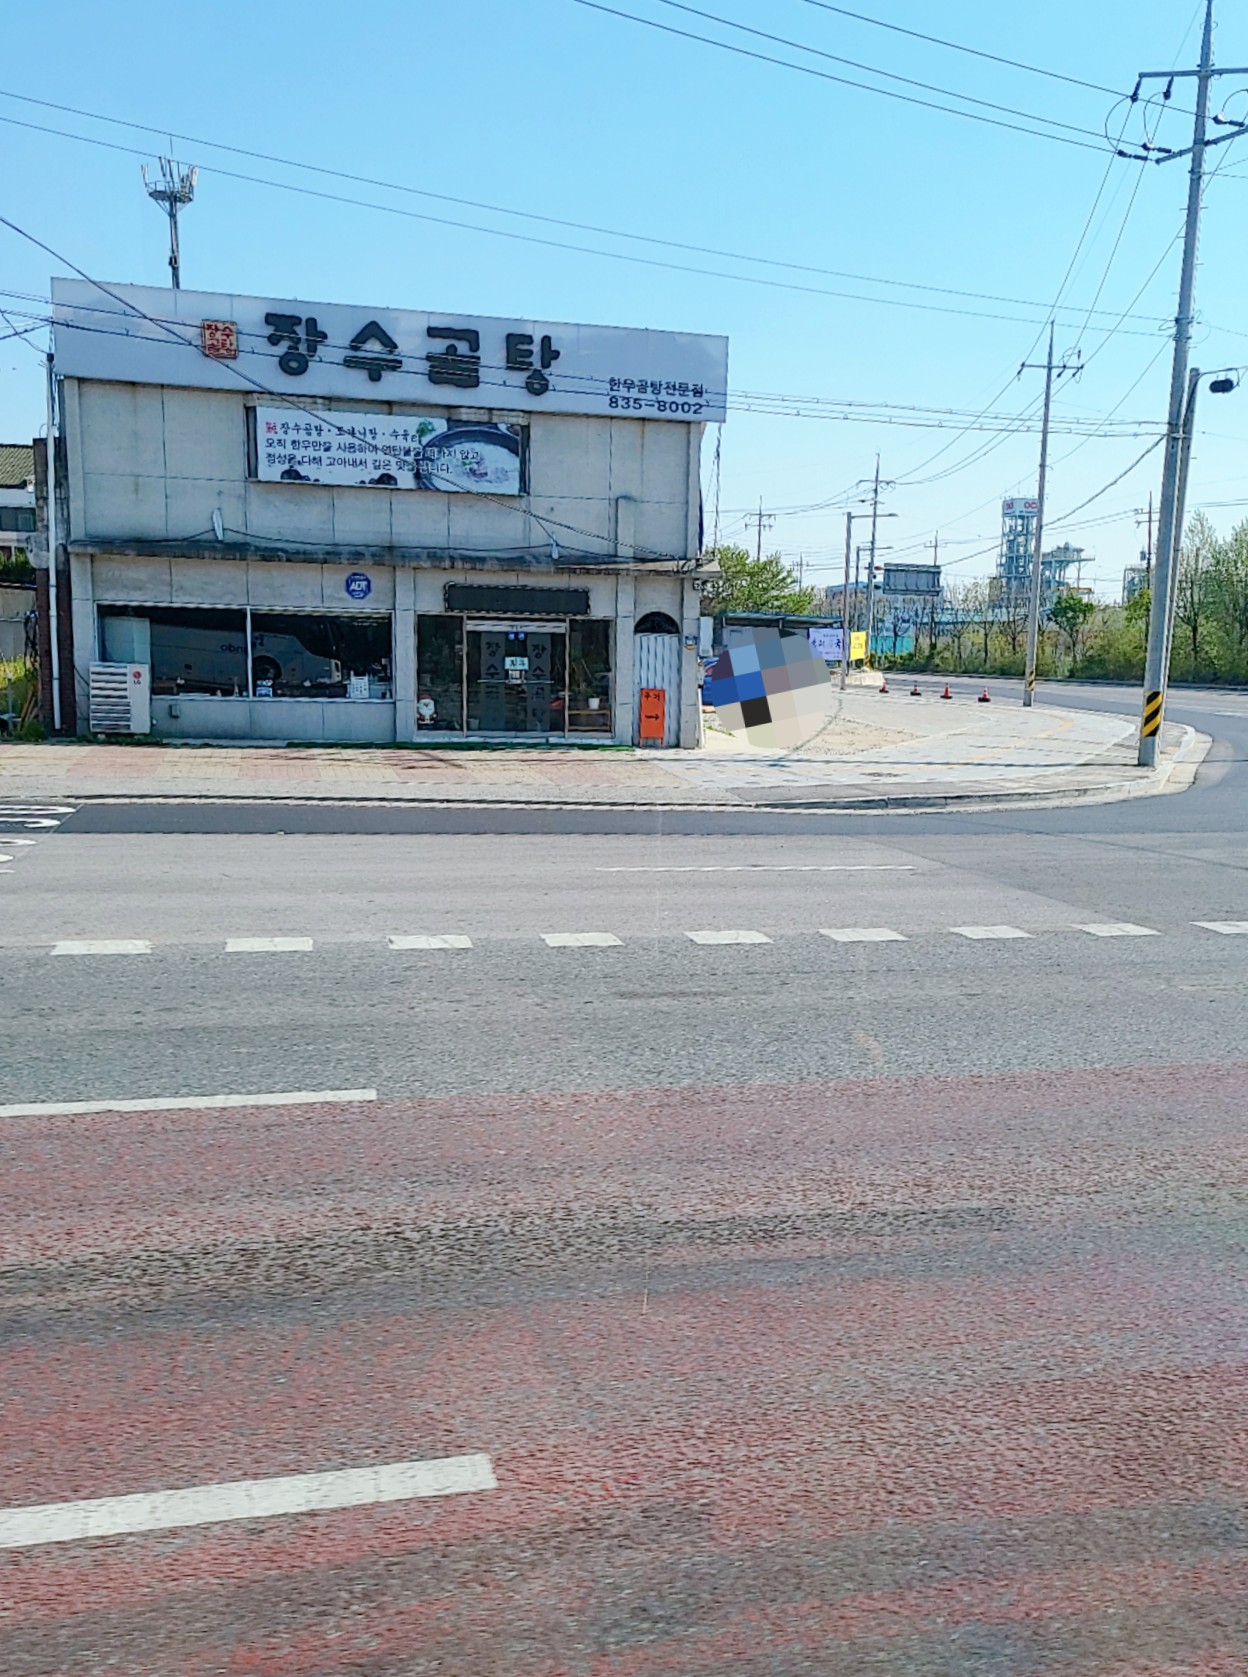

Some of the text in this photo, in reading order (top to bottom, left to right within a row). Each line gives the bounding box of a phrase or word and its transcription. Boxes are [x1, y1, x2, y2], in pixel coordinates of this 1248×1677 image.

[264, 312, 561, 396] 장수곰탕
[608, 395, 703, 415] 835-8002
[350, 581, 368, 591] ADT
